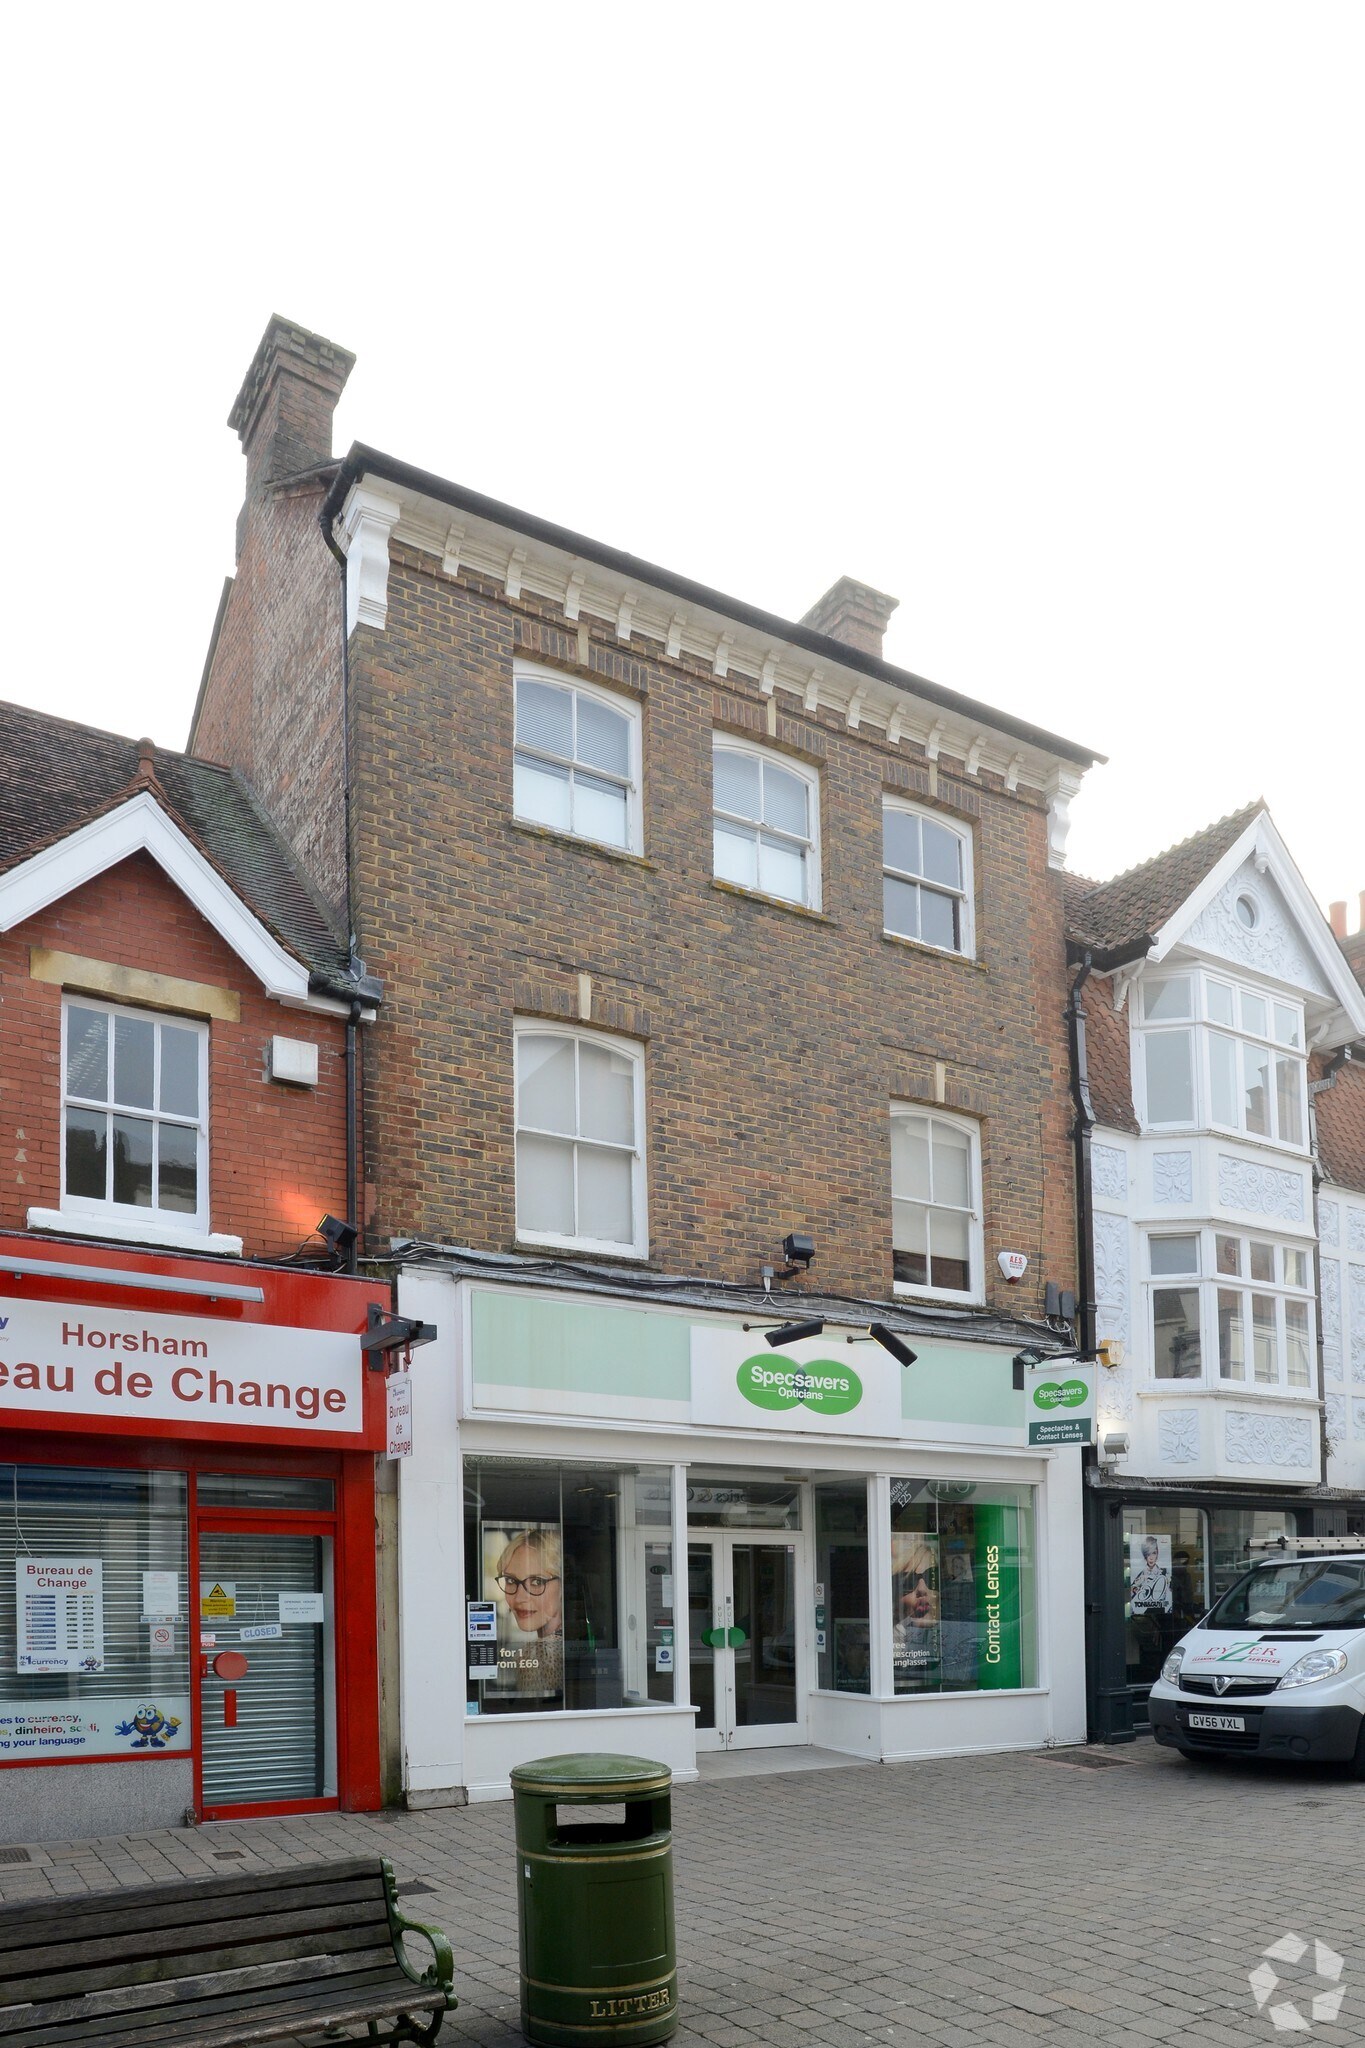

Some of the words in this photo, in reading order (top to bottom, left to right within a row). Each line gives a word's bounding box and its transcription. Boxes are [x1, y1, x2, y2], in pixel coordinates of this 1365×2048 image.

[62, 1322, 208, 1358] Horsham
[750, 1365, 850, 1392] Specsavers
[94, 1361, 153, 1399] de
[171, 1367, 347, 1420] Change
[778, 1386, 824, 1401] Opticians
[1038, 1387, 1083, 1400] Specsavers
[389, 1403, 410, 1419] Bureau
[395, 1421, 403, 1435] de
[1039, 1424, 1073, 1434] Spectacles
[1036, 1433, 1060, 1441] Contact
[1061, 1431, 1084, 1439] Lenses
[389, 1440, 412, 1455] Change
[890, 1480, 904, 1498] NOW
[897, 1490, 912, 1508] £25
[26, 1565, 74, 1576] Bureau
[77, 1565, 94, 1576] de
[985, 1545, 1000, 1599] Lenses
[37, 1577, 88, 1590] Change
[244, 1626, 278, 1638] CLOSED
[986, 1603, 1001, 1664] Contact
[500, 1647, 516, 1657] for
[519, 1648, 523, 1657] 1
[893, 1650, 930, 1659] rescription
[1206, 1642, 1278, 1662] PYZER
[31, 1658, 69, 1666] currency
[497, 1660, 517, 1669] rom
[519, 1659, 539, 1669] £69
[893, 1658, 928, 1668] unglasses
[15, 1716, 26, 1724] to
[28, 1714, 82, 1724] currency,
[1192, 1715, 1218, 1727] GV56
[1220, 1718, 1240, 1729] VXL
[15, 1725, 66, 1735] dinheiro,
[13, 1739, 37, 1748] your
[39, 1737, 86, 1746] language
[589, 1988, 670, 2017] LITTER
